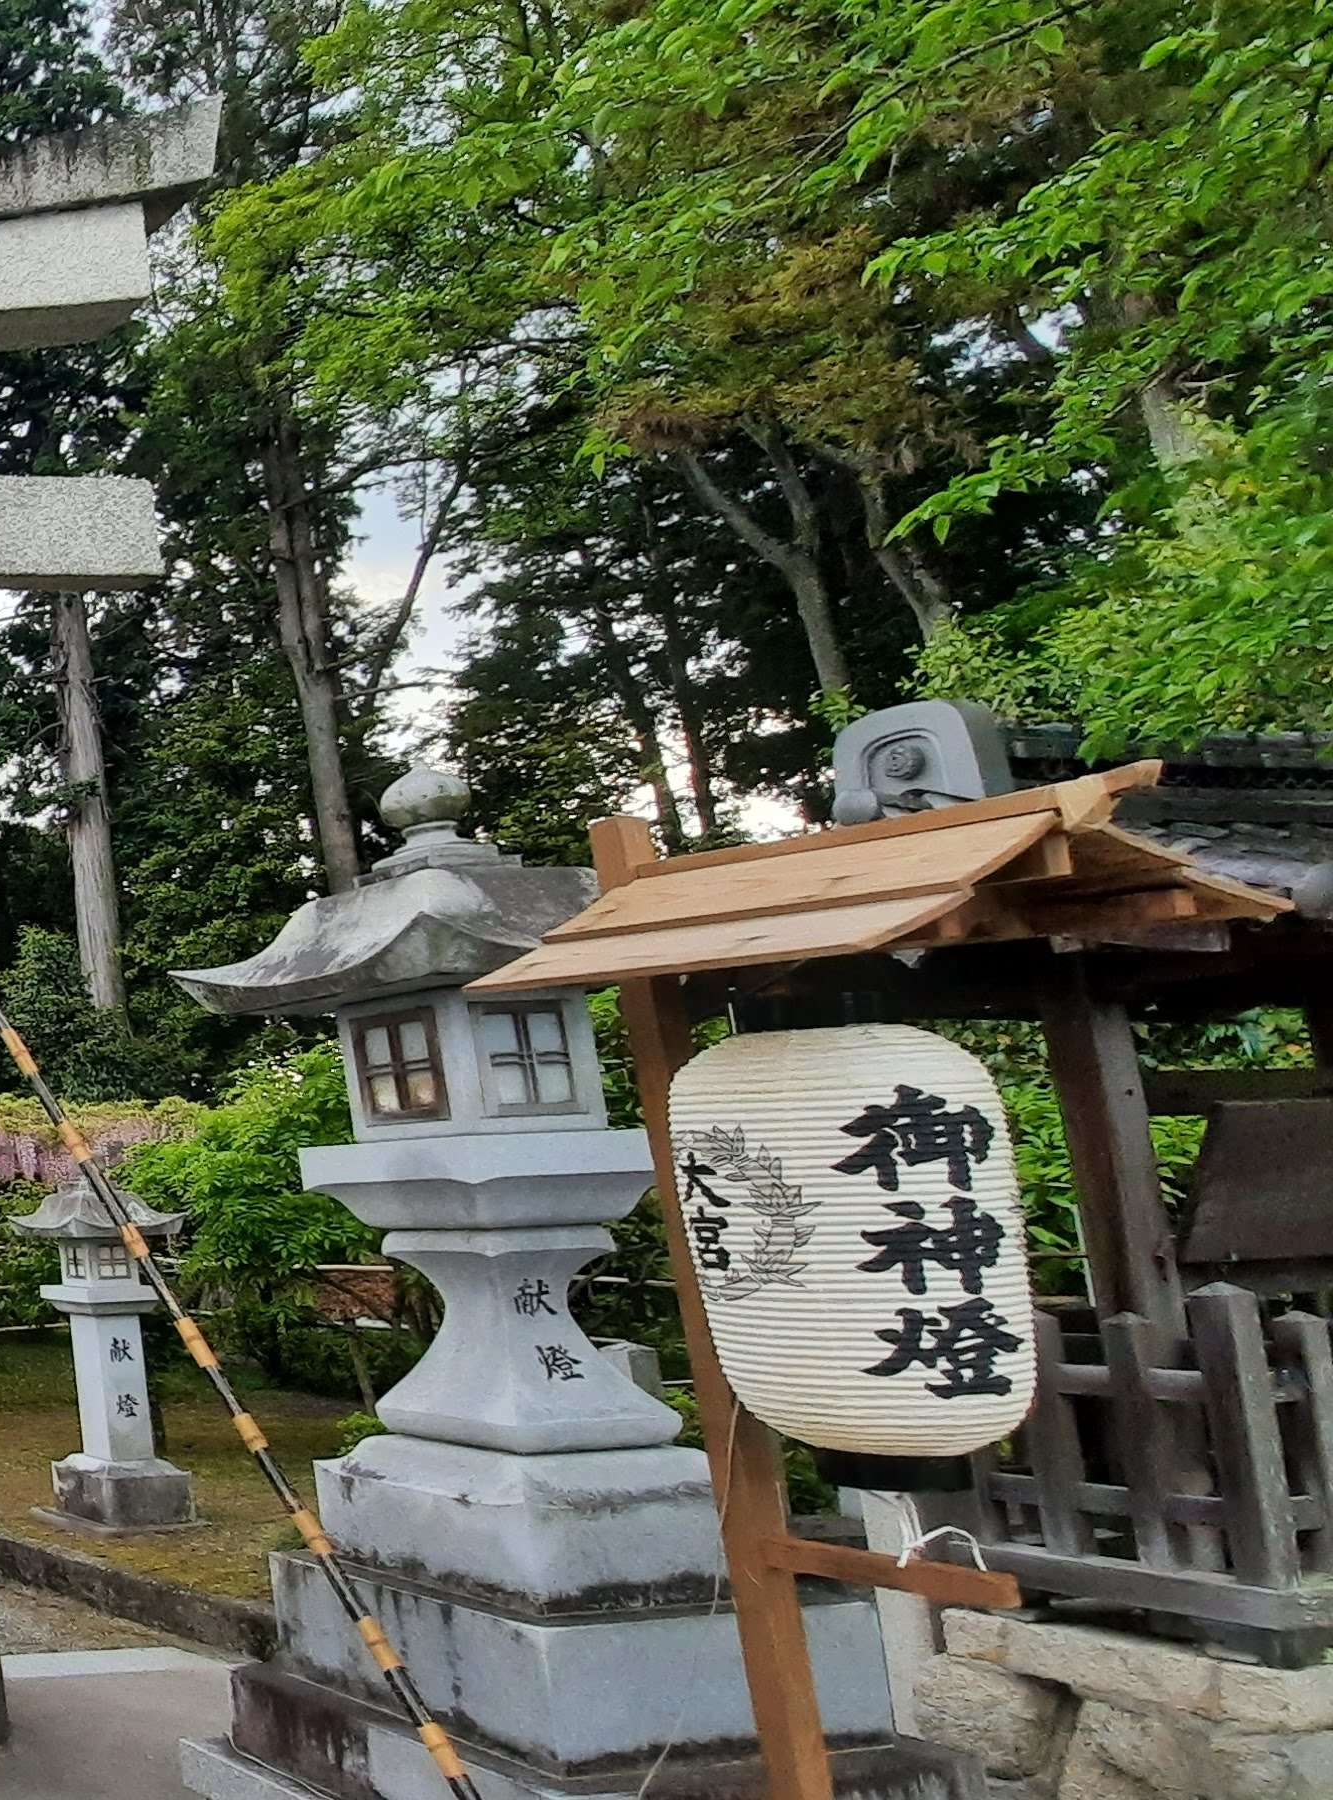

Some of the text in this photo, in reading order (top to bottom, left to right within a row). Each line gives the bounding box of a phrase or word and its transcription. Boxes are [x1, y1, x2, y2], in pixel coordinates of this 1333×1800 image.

[682, 1152, 731, 1271] 大宮
[830, 1084, 1025, 1399] 御神燈
[110, 1336, 139, 1418] 献燈
[513, 1278, 585, 1381] 献燈
